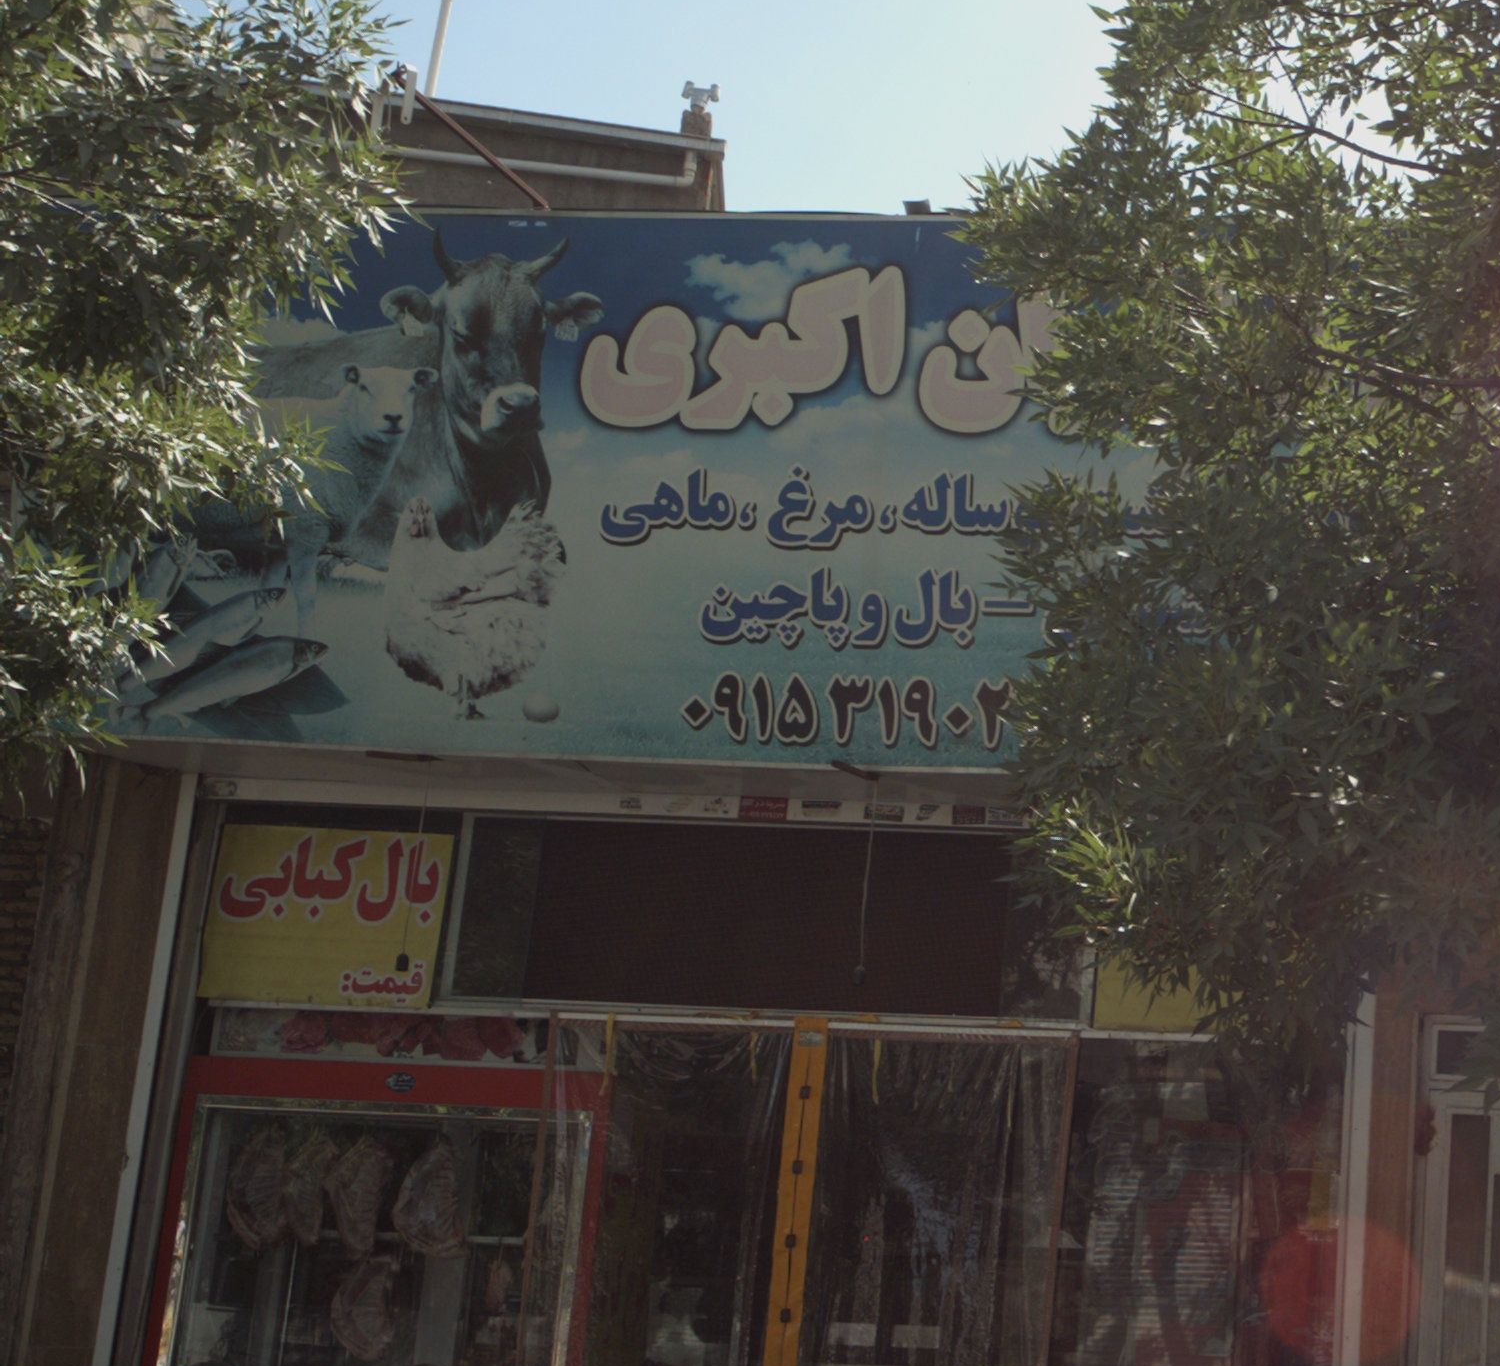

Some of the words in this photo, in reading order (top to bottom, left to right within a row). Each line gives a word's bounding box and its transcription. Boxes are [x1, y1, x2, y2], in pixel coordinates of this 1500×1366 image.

[579, 265, 907, 432] اکبری
[767, 465, 872, 549] مرغ
[699, 566, 850, 648] پاچین
[848, 587, 888, 648] و
[893, 567, 977, 649] بال
[217, 834, 369, 920] کبابی
[354, 836, 442, 926] بال
[340, 963, 426, 1003] قیمت:
